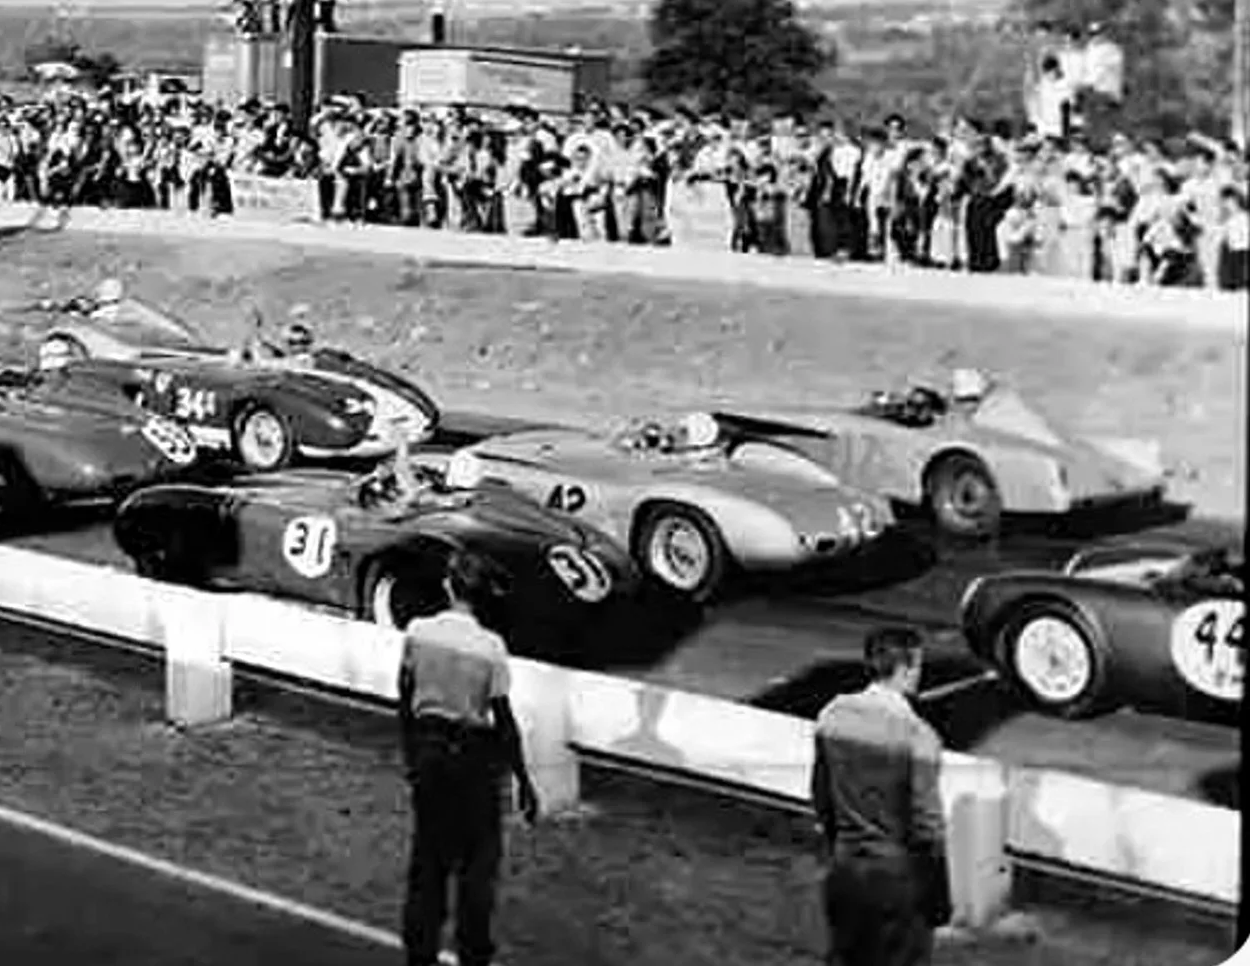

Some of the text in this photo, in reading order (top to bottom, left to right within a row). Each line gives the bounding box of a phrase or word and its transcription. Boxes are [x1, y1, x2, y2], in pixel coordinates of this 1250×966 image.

[547, 485, 586, 512] 42
[289, 521, 328, 566] 31
[550, 552, 606, 589] 31
